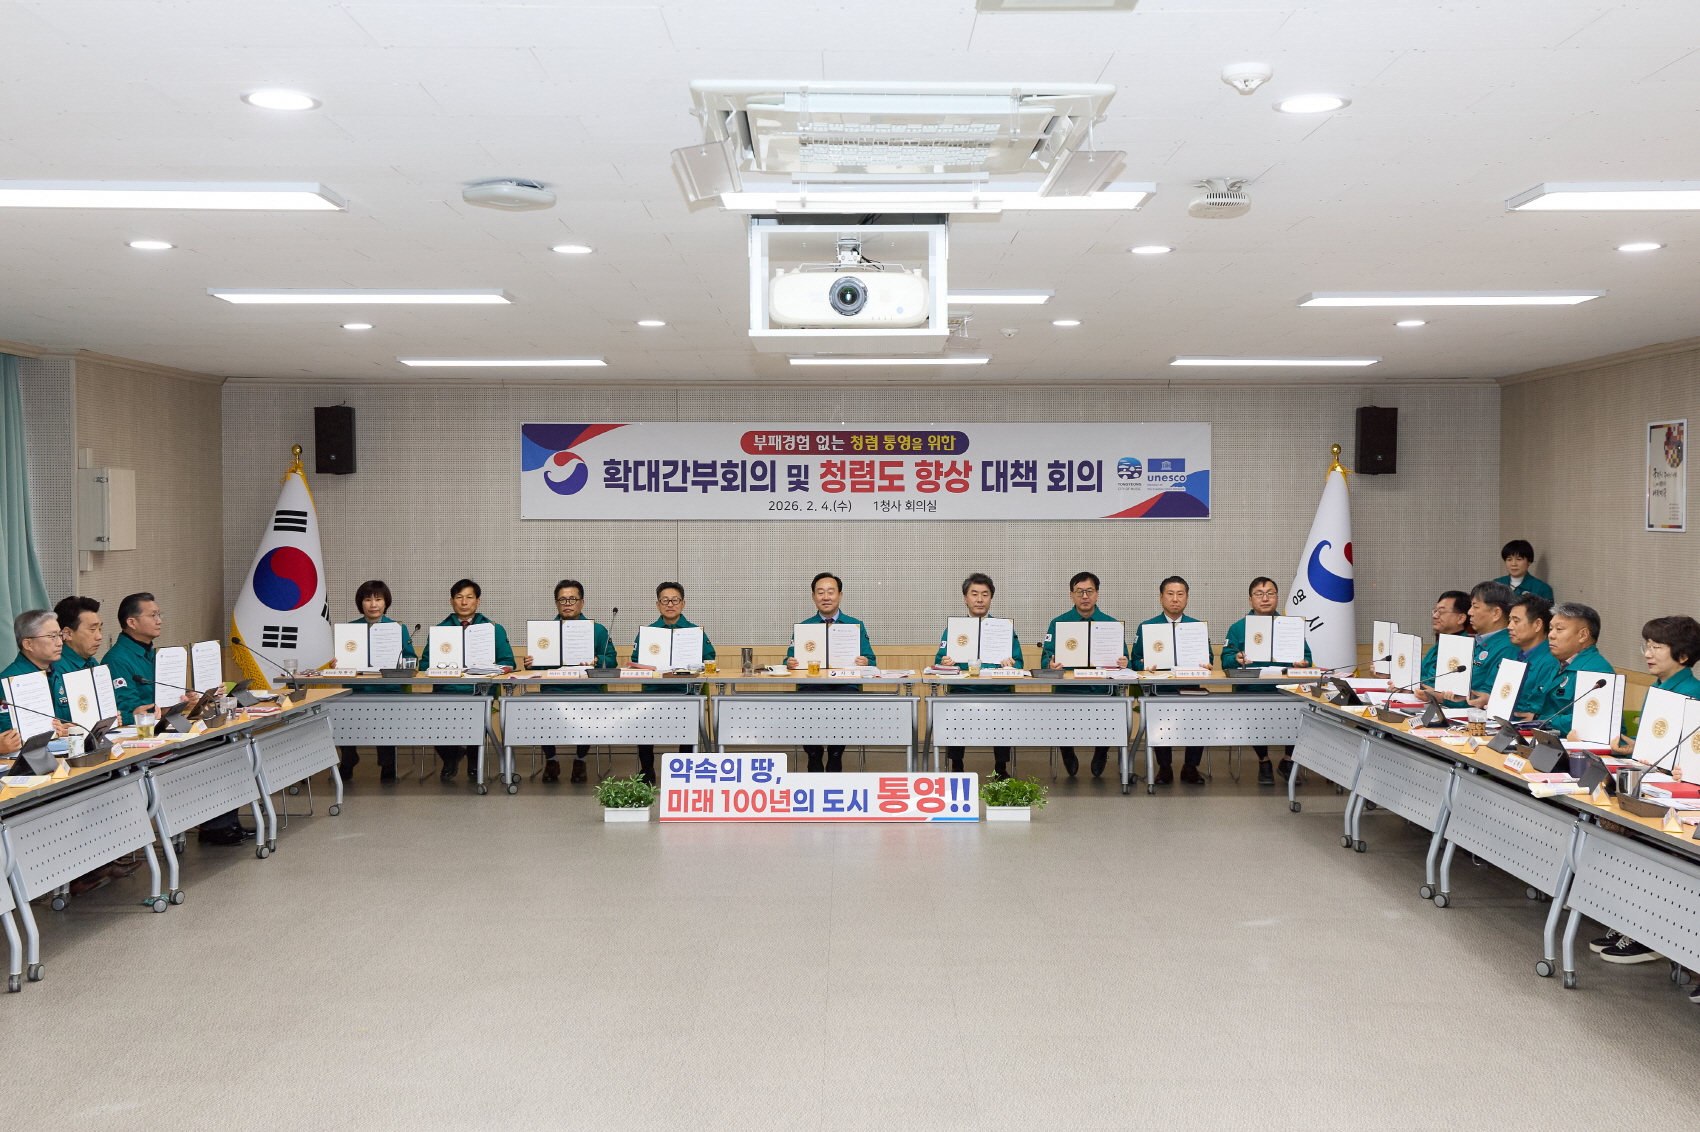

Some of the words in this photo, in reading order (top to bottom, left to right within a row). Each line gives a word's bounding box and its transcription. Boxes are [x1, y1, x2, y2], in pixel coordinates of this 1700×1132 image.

[753, 435, 810, 451] 부패경험
[816, 435, 845, 451] 없는
[850, 435, 878, 451] 청렴
[882, 435, 923, 451] 통영을
[927, 435, 956, 451] 위한
[603, 459, 776, 493] 확대간부회의
[787, 464, 810, 493] 및
[820, 459, 906, 493] 청렴도
[914, 459, 972, 493] 향상
[981, 459, 1038, 493] 대책
[1047, 459, 1103, 493] 회의
[768, 500, 802, 512] 2026.
[806, 500, 818, 512] 2.
[821, 500, 852, 513] 4.(수)
[873, 499, 902, 513] 1청사
[905, 499, 937, 513] 회의실
[669, 757, 743, 784] 약속의
[750, 757, 782, 785] 땅,
[668, 788, 714, 813] 미래
[720, 788, 814, 813] 100년의
[822, 788, 869, 813] 도시
[876, 776, 972, 814] 통영!!
